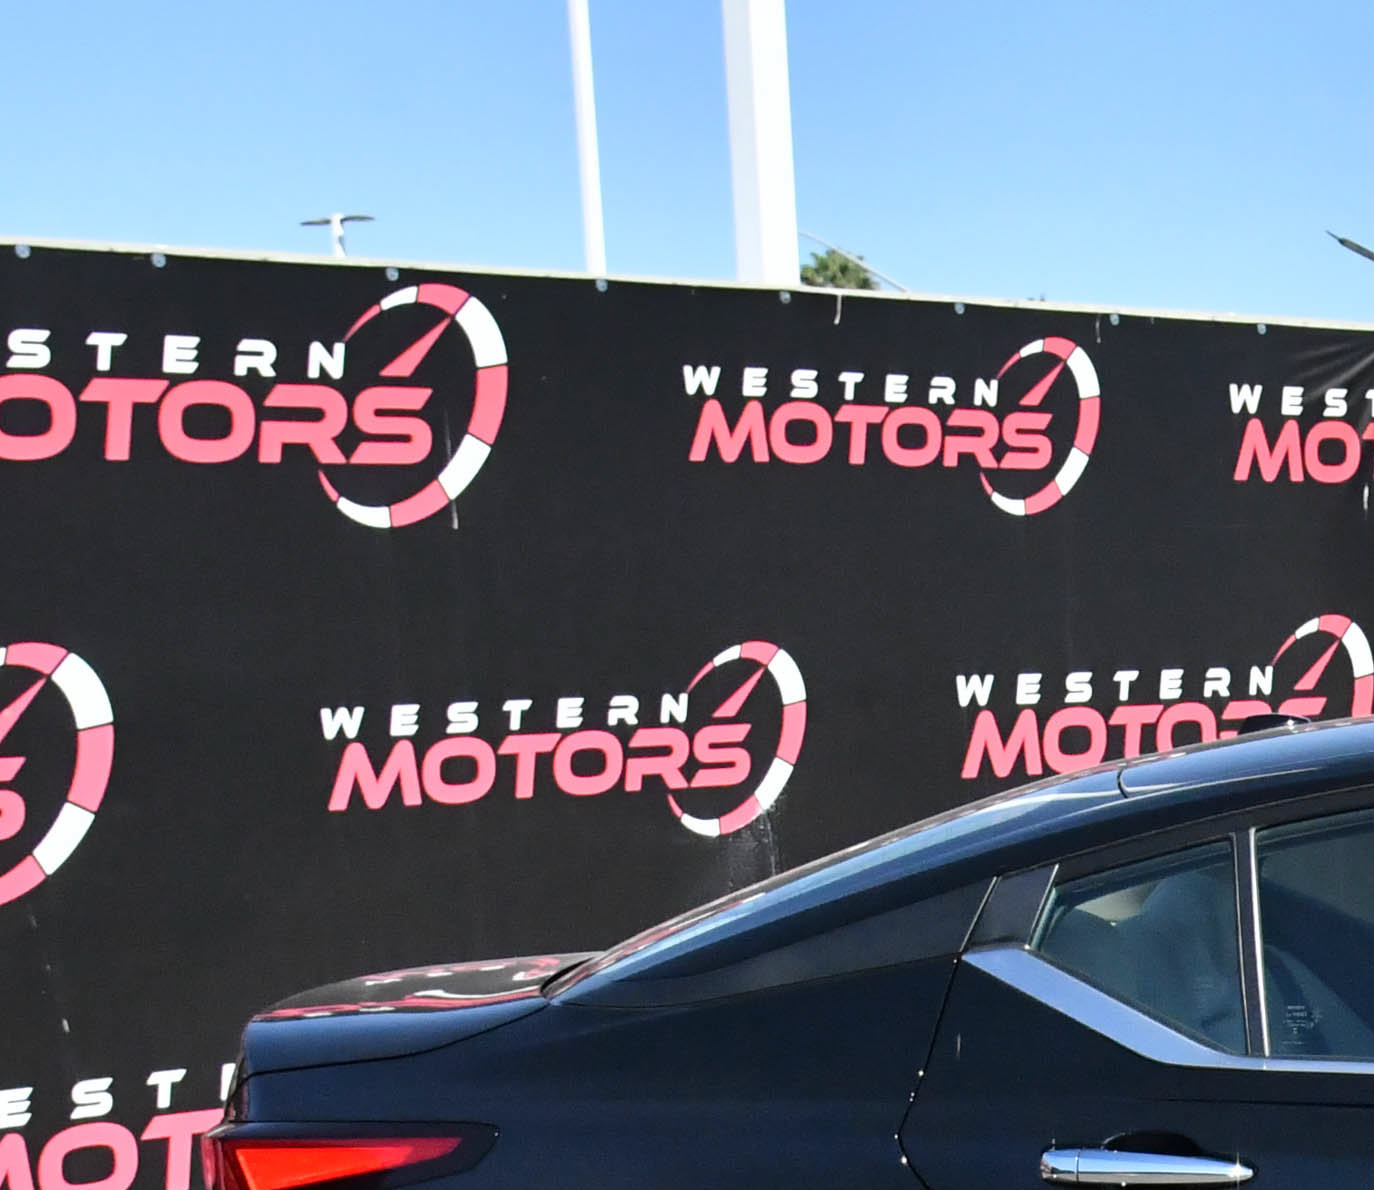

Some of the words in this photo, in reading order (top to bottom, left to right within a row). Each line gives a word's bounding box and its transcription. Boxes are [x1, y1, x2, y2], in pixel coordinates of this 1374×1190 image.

[6, 328, 345, 380] STERN
[683, 364, 998, 408] WESTERN
[0, 373, 433, 465] OTORS
[688, 399, 1053, 470] MOTORS
[956, 665, 1274, 708] WESTERN
[320, 693, 689, 741] WESTERN
[327, 723, 752, 812] MOTORS
